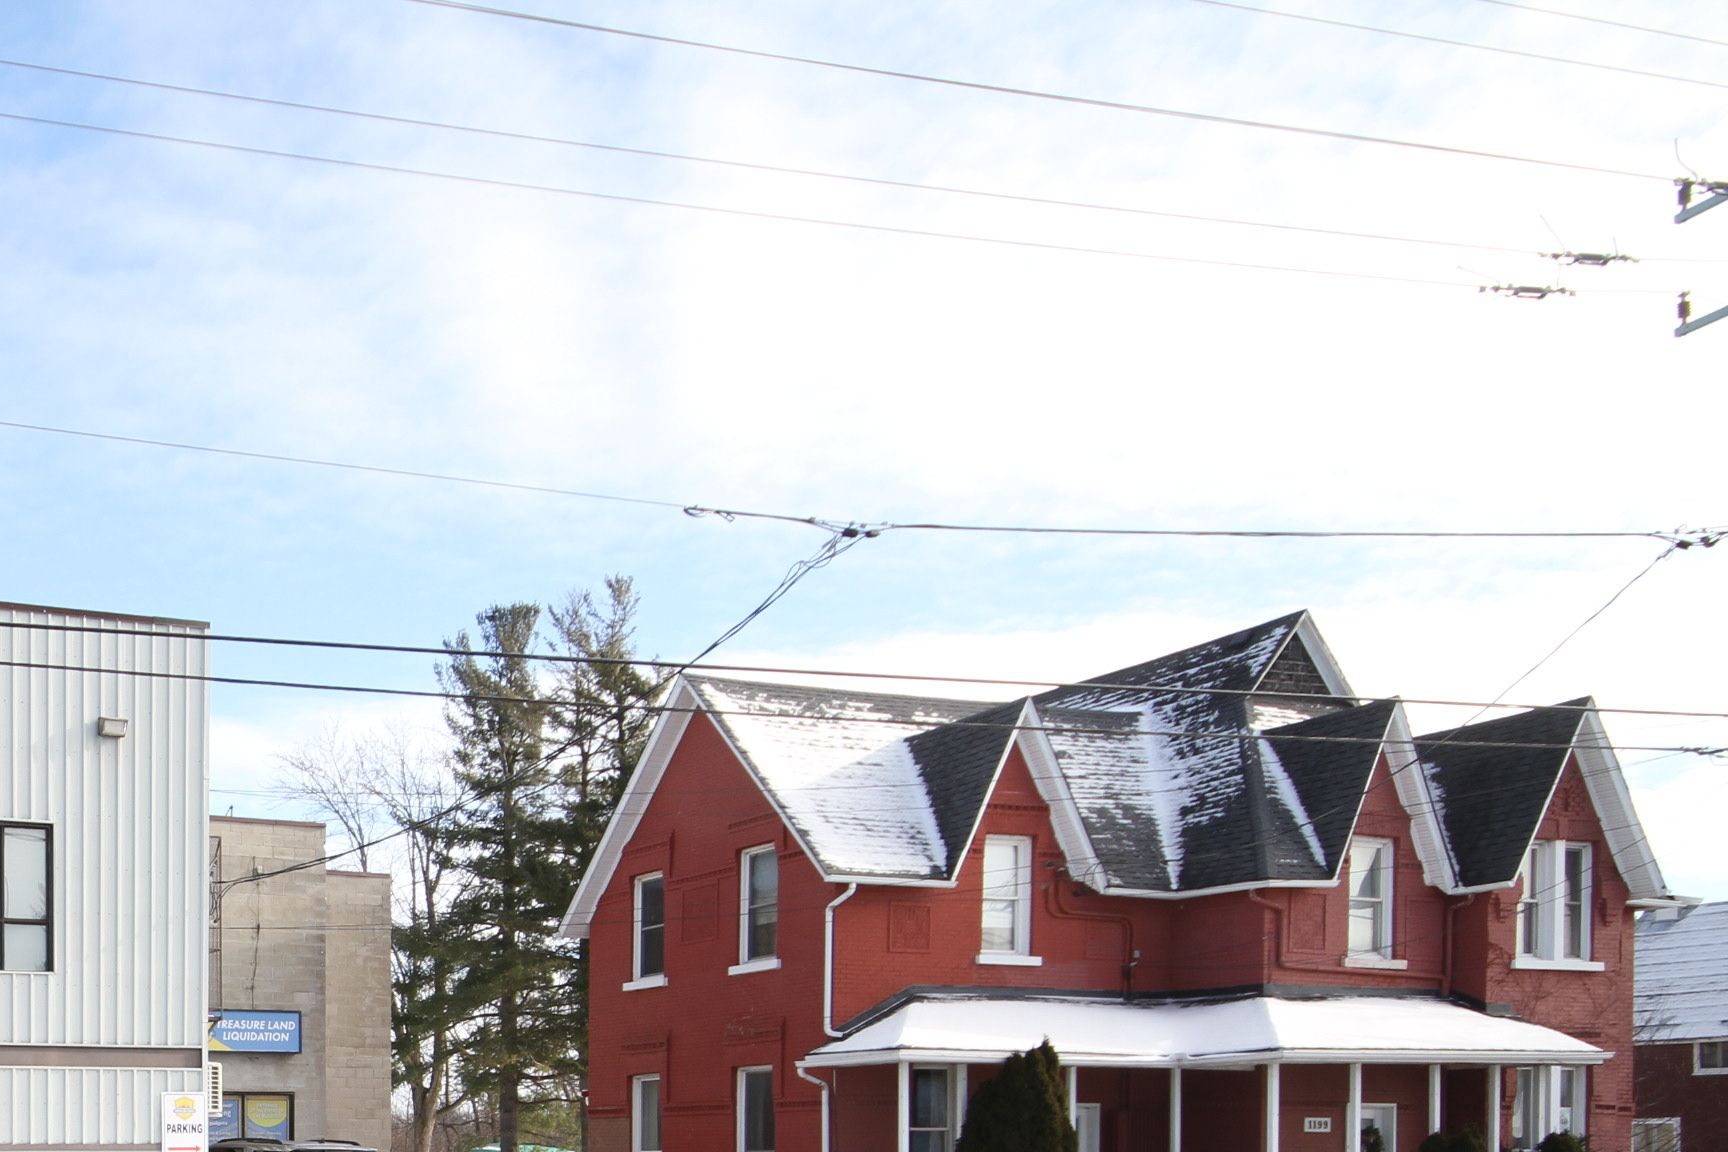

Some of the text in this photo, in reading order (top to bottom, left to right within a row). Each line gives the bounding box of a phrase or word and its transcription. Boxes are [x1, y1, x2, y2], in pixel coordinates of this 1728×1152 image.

[217, 1020, 296, 1031] TREASURE LAND
[223, 1031, 290, 1042] LIQUIDATION
[167, 1124, 203, 1134] PARKING
[1308, 1120, 1329, 1130] 1199
